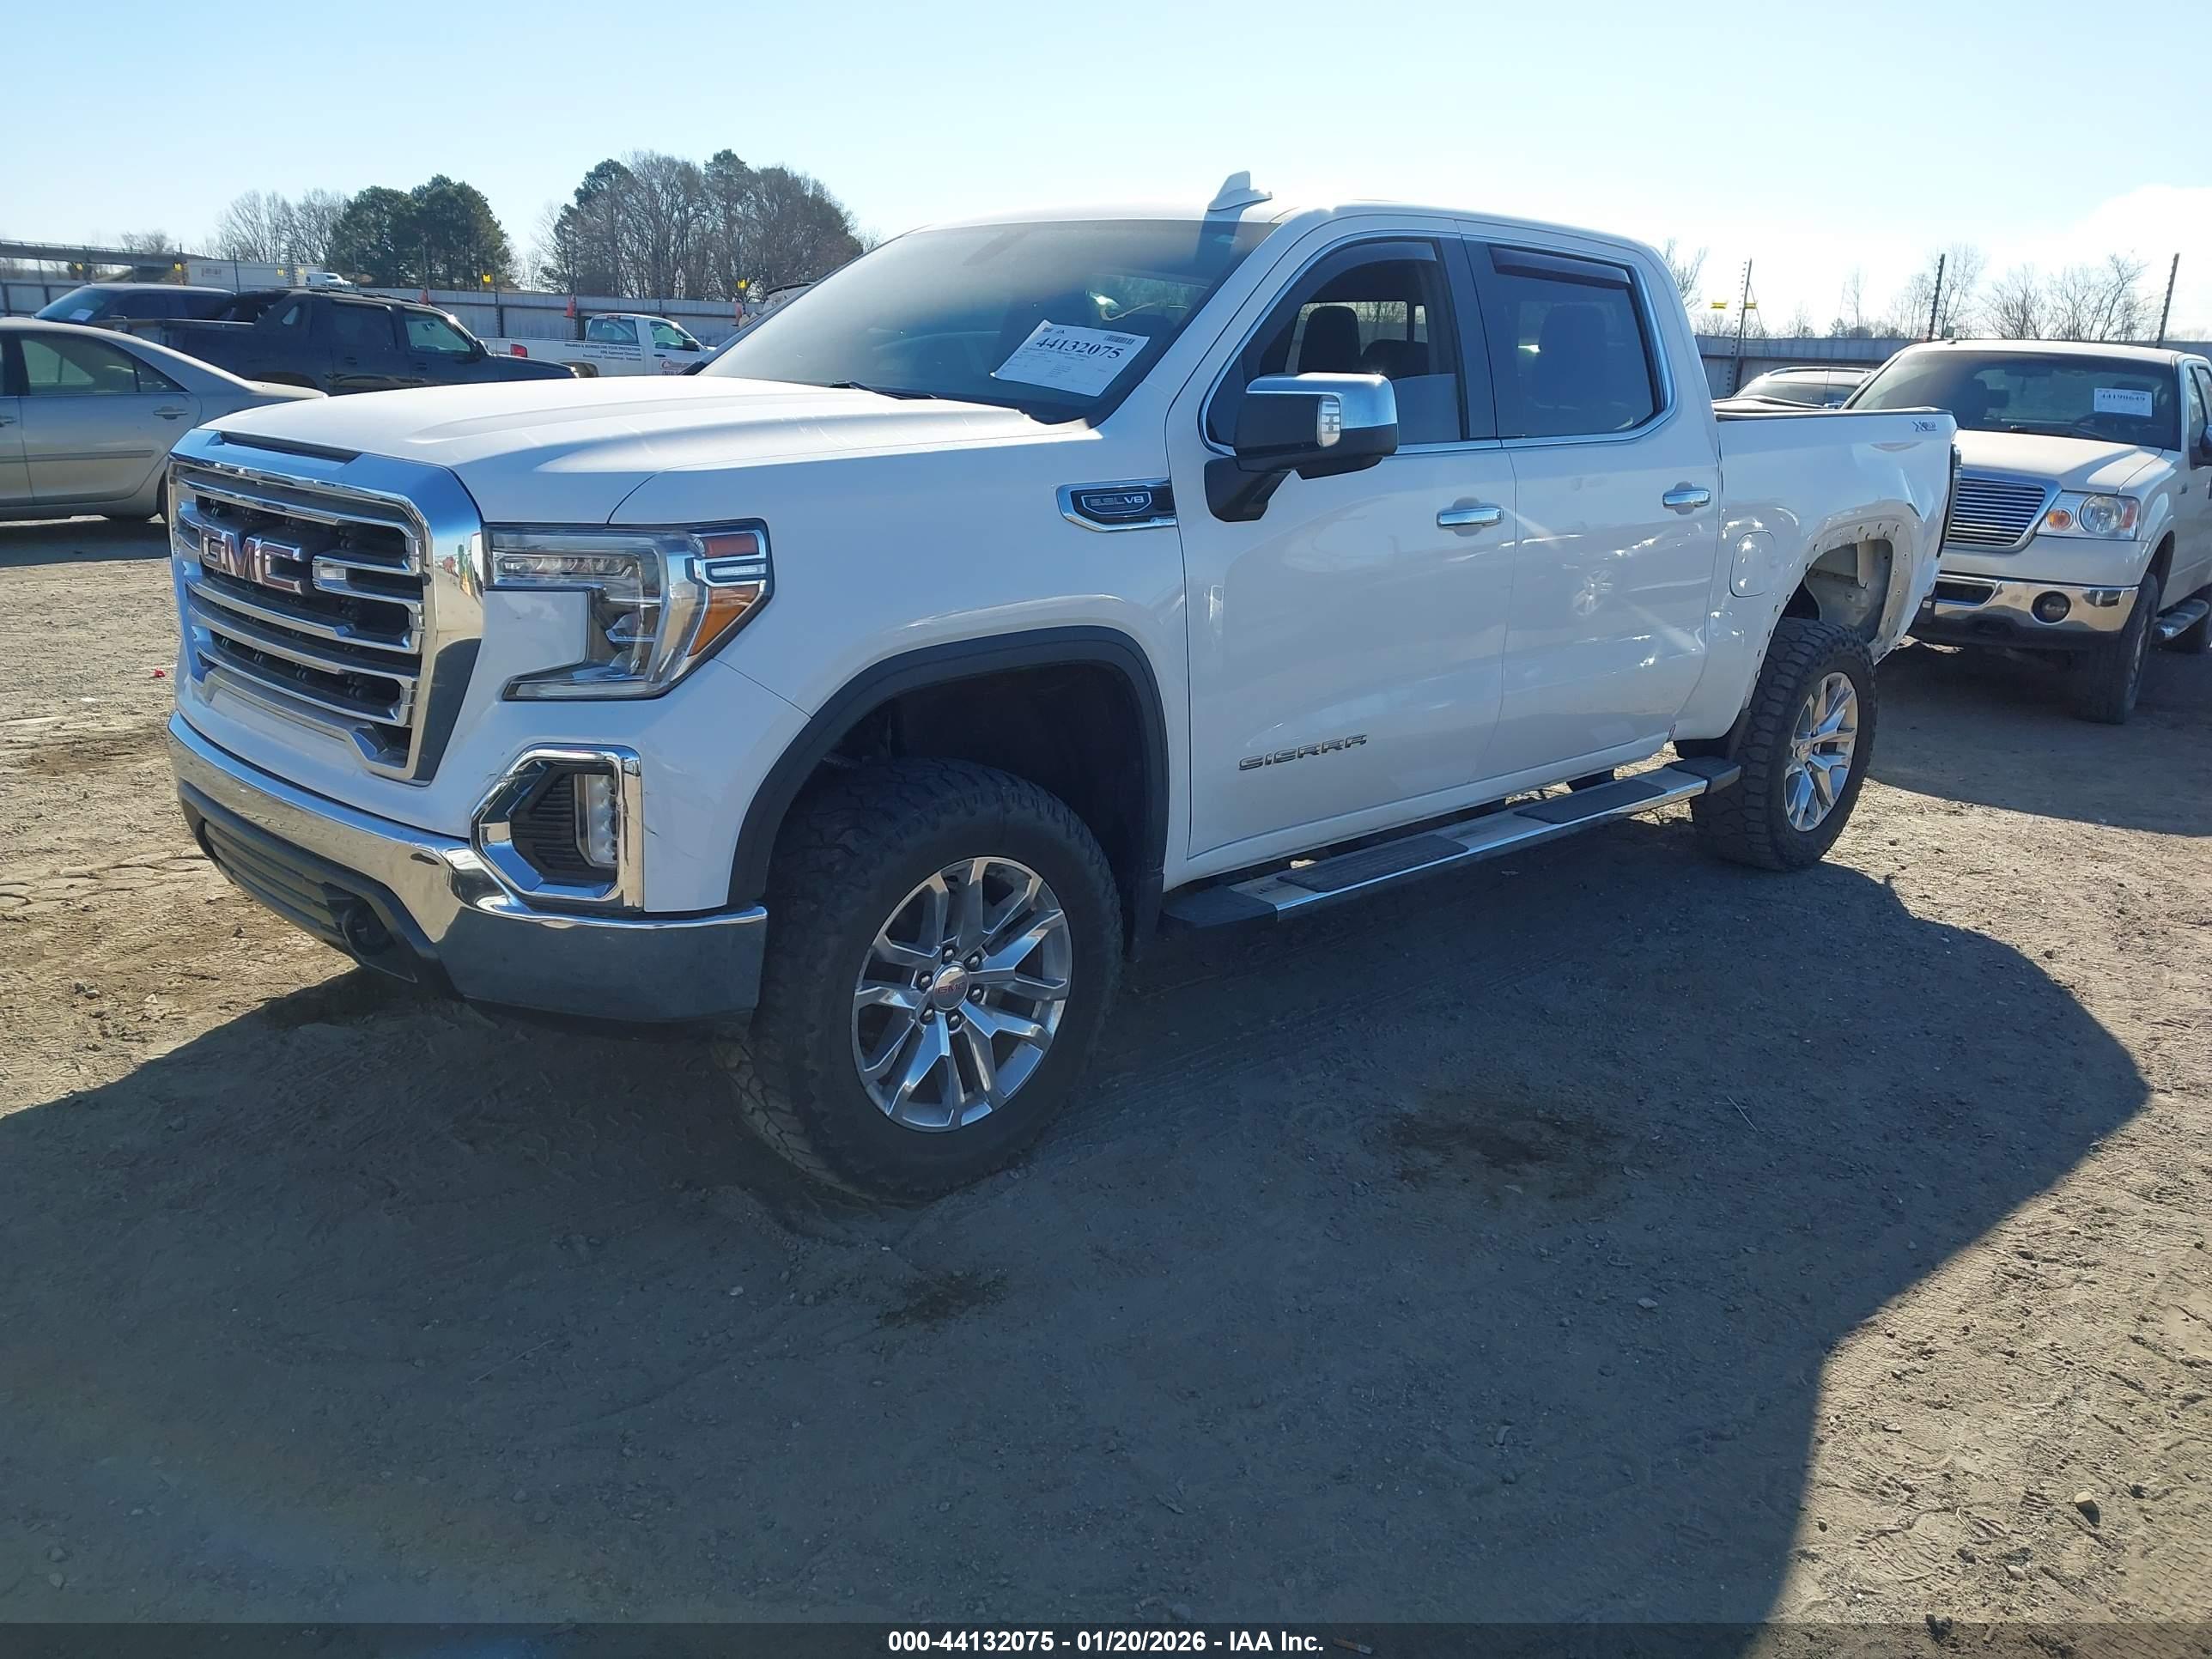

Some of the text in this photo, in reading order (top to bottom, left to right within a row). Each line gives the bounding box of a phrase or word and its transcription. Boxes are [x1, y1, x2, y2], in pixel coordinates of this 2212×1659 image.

[1036, 337, 1126, 359] 44132075
[1124, 495, 1145, 504] V8
[200, 523, 302, 594] GMC
[1238, 734, 1368, 771] SIERRA
[938, 982, 965, 995] GMC
